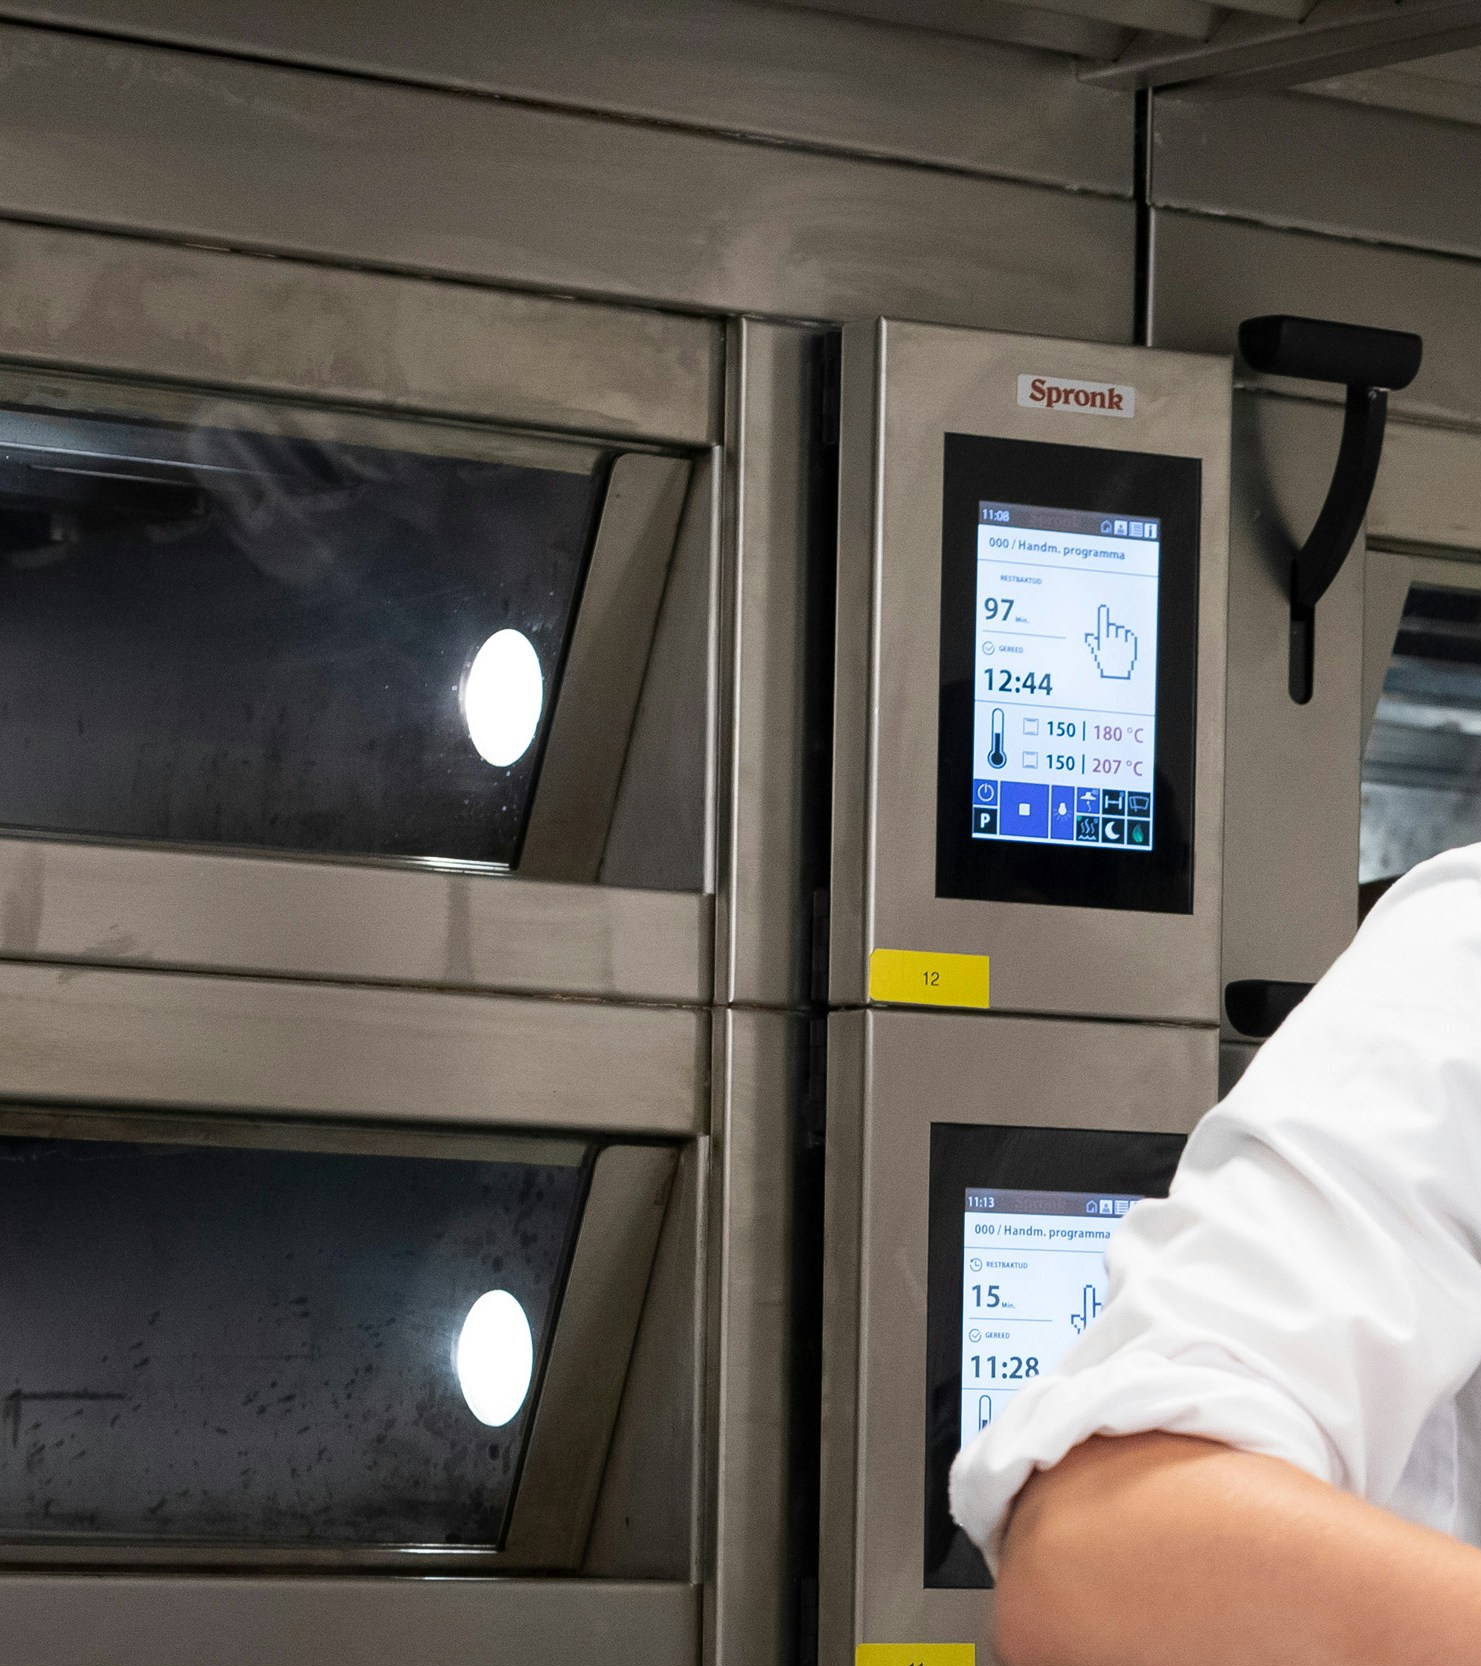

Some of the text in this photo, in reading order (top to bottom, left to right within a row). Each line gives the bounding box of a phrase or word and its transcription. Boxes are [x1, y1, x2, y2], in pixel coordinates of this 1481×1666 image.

[1029, 378, 1124, 411] Spronk
[982, 509, 1010, 522] 11:08
[989, 537, 1010, 549] 000
[1018, 540, 1061, 554] Handm.
[1063, 546, 1126, 560] programma
[984, 597, 1015, 621] 97
[984, 668, 1053, 696] 12:44
[1047, 721, 1076, 738] 150
[1094, 725, 1123, 742] 180
[1046, 754, 1075, 771] 150
[1092, 758, 1122, 775] 207
[923, 971, 940, 987] 12
[968, 1196, 995, 1208] 11:13
[974, 1224, 995, 1235] 000
[1004, 1225, 1047, 1237] Handm.
[1049, 1228, 1111, 1241] programma
[972, 1285, 1000, 1308] 15
[971, 1355, 1040, 1380] 11:28
